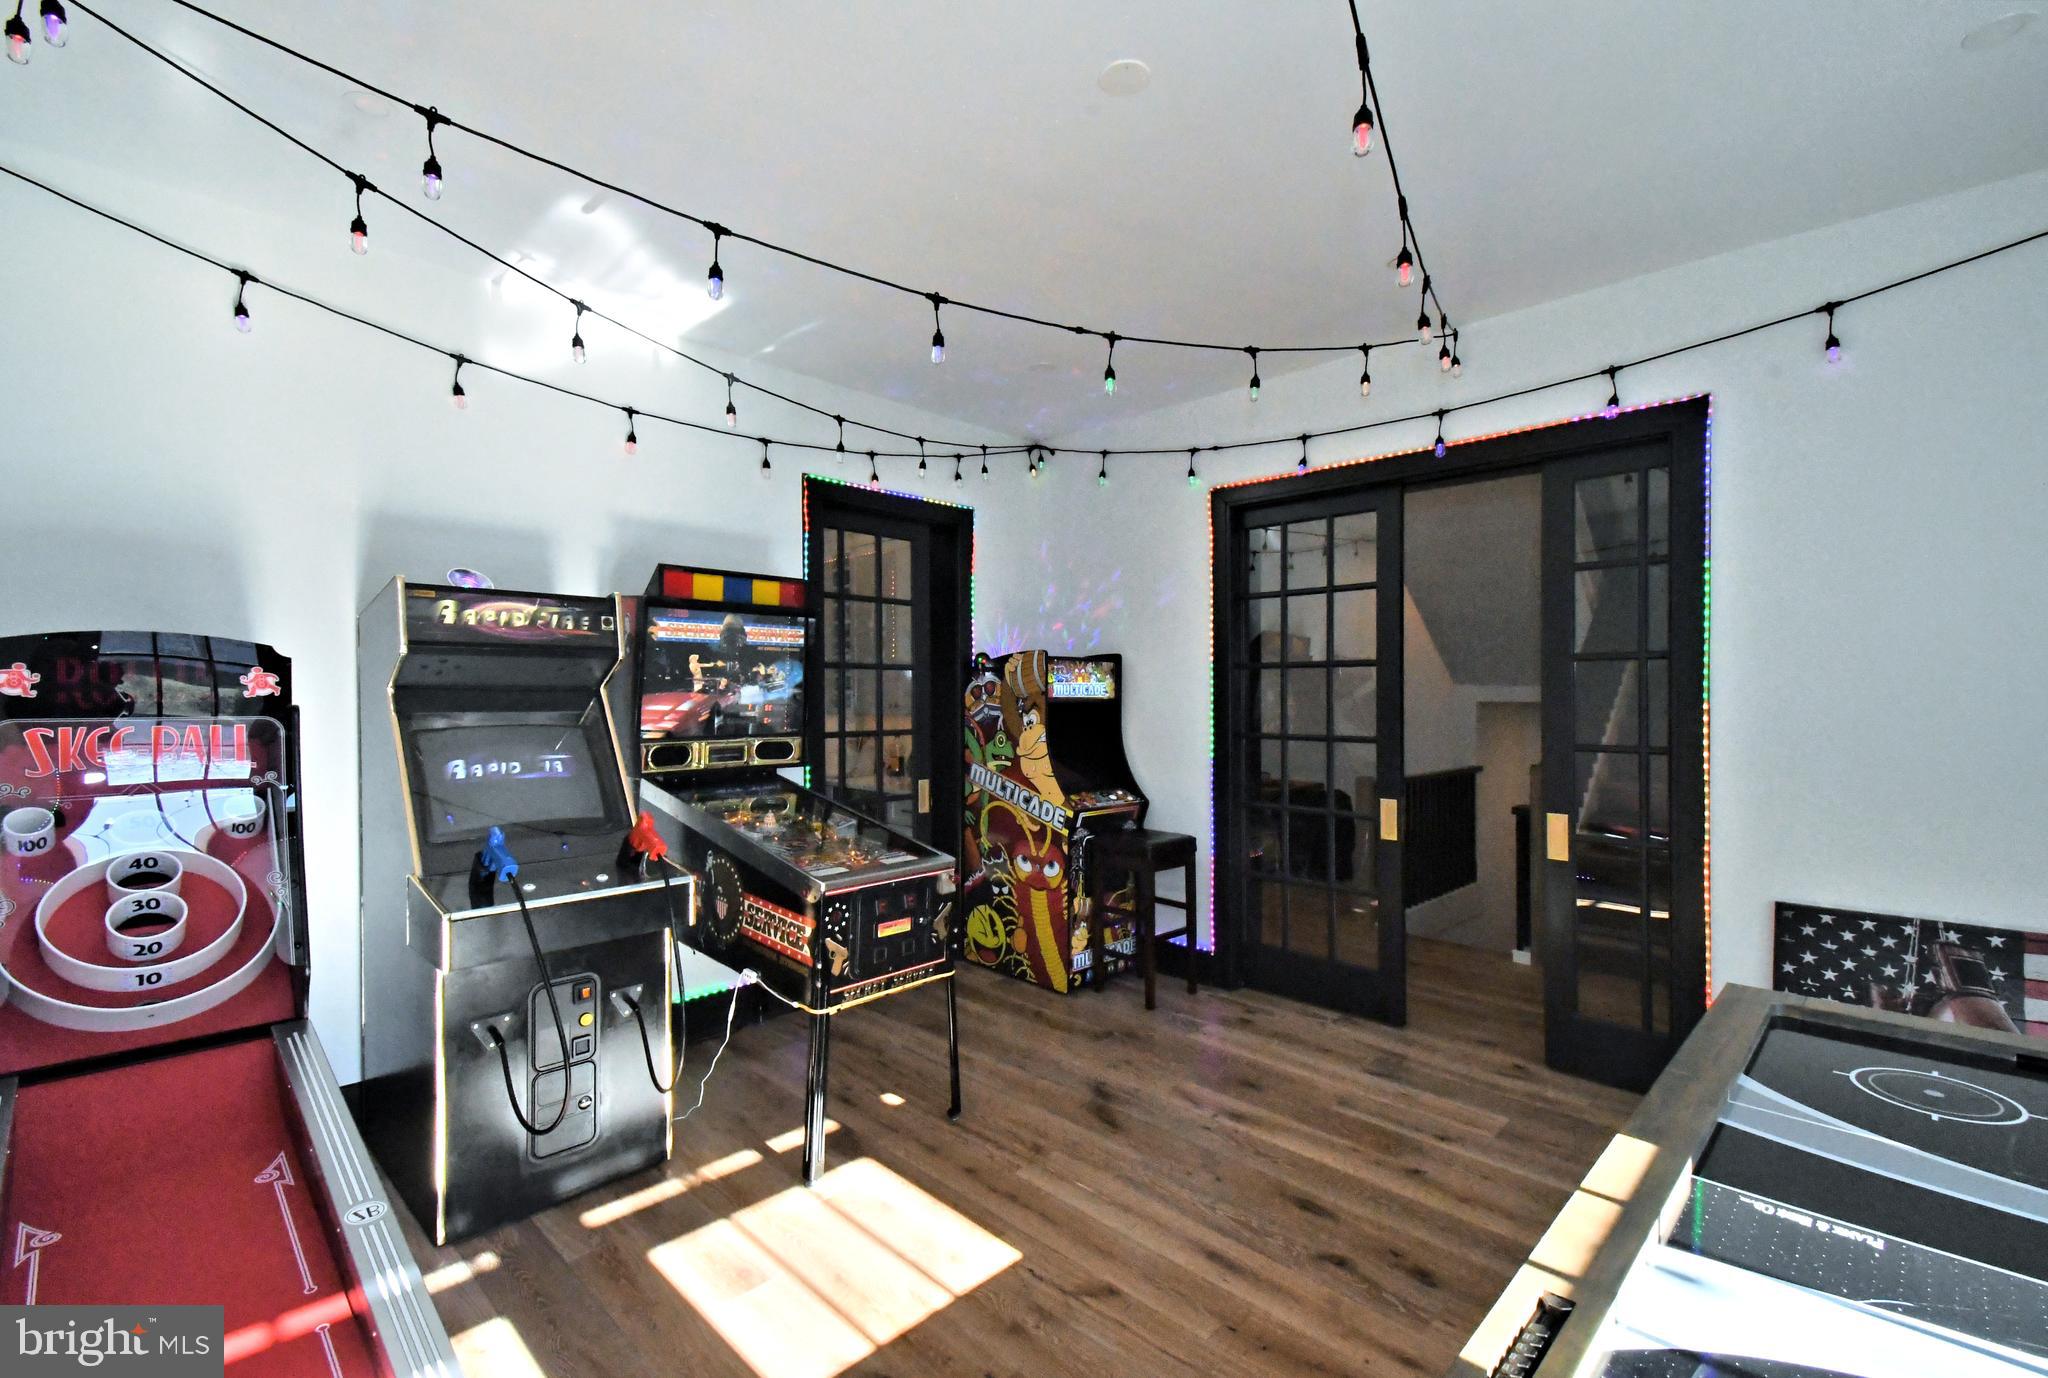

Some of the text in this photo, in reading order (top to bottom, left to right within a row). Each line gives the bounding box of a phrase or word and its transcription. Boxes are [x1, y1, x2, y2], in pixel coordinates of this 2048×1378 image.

[1053, 683, 1106, 696] MULTICADE
[970, 762, 1067, 831] MULTICADE
[231, 821, 256, 835] 100
[18, 836, 48, 852] 100
[129, 857, 159, 870] 40
[132, 897, 161, 911] 30
[743, 901, 807, 953] SERVICE
[133, 941, 163, 956] 20
[135, 972, 162, 986] 10
